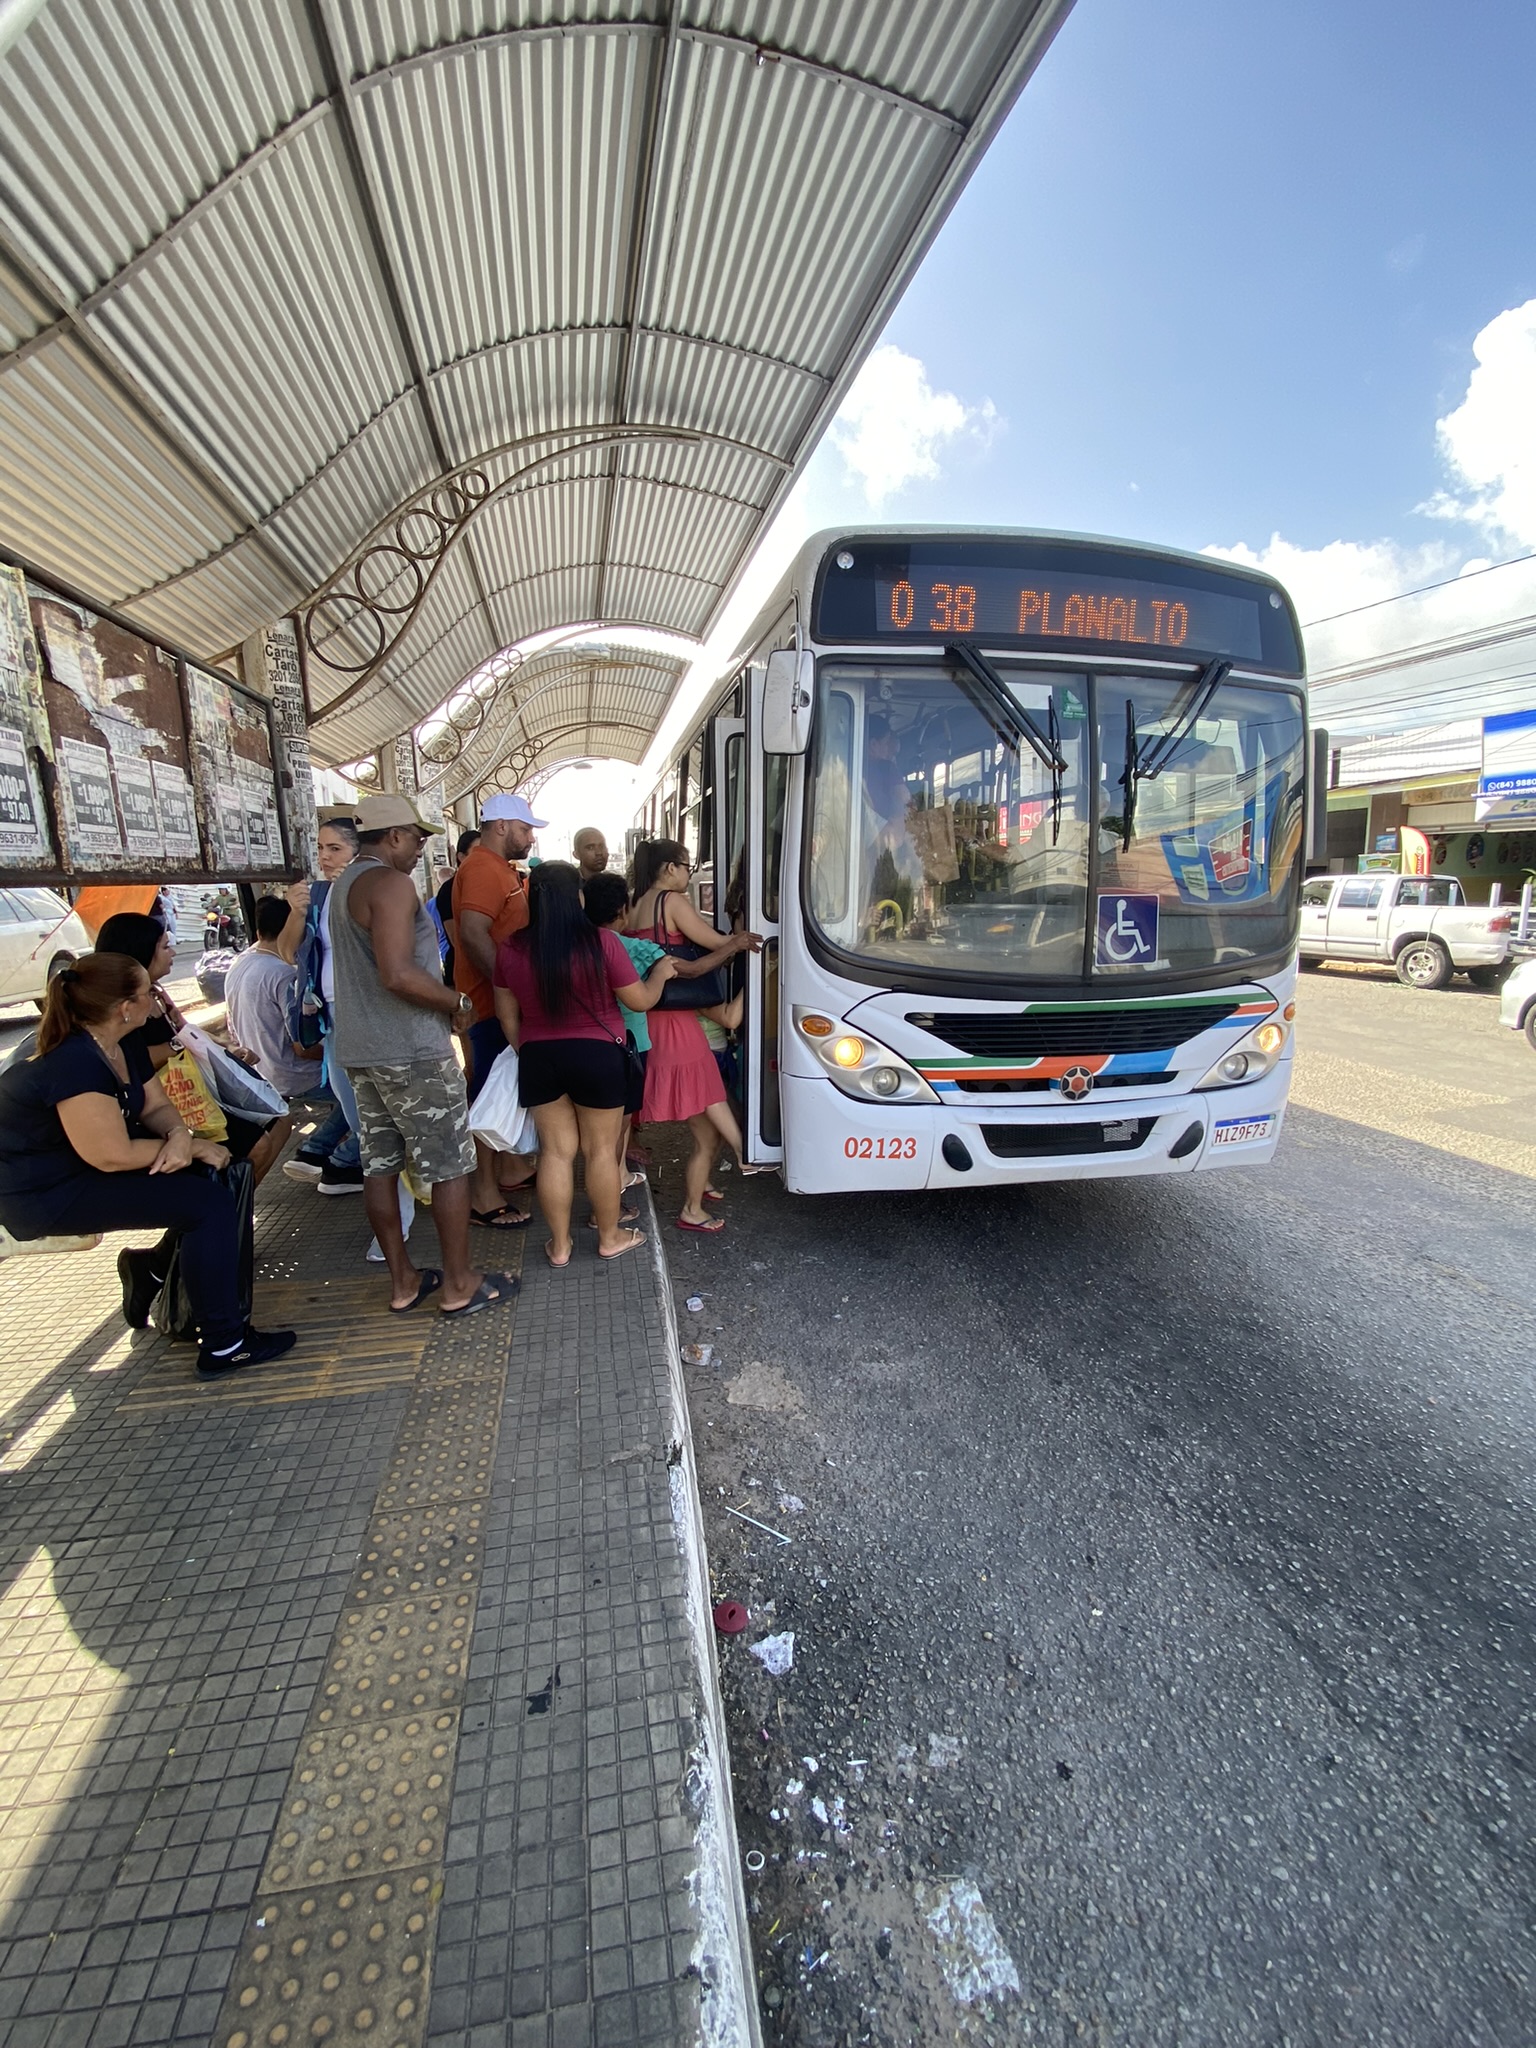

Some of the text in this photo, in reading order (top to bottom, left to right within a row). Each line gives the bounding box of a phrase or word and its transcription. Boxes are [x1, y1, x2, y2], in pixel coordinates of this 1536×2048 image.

[930, 583, 976, 632] 38
[1017, 590, 1188, 645] PLANALTO
[1496, 782, 1514, 790] (84)
[7, 801, 31, 823] 97,90
[1214, 1122, 1268, 1144] HIZ9F73
[844, 1136, 917, 1160] 02123
